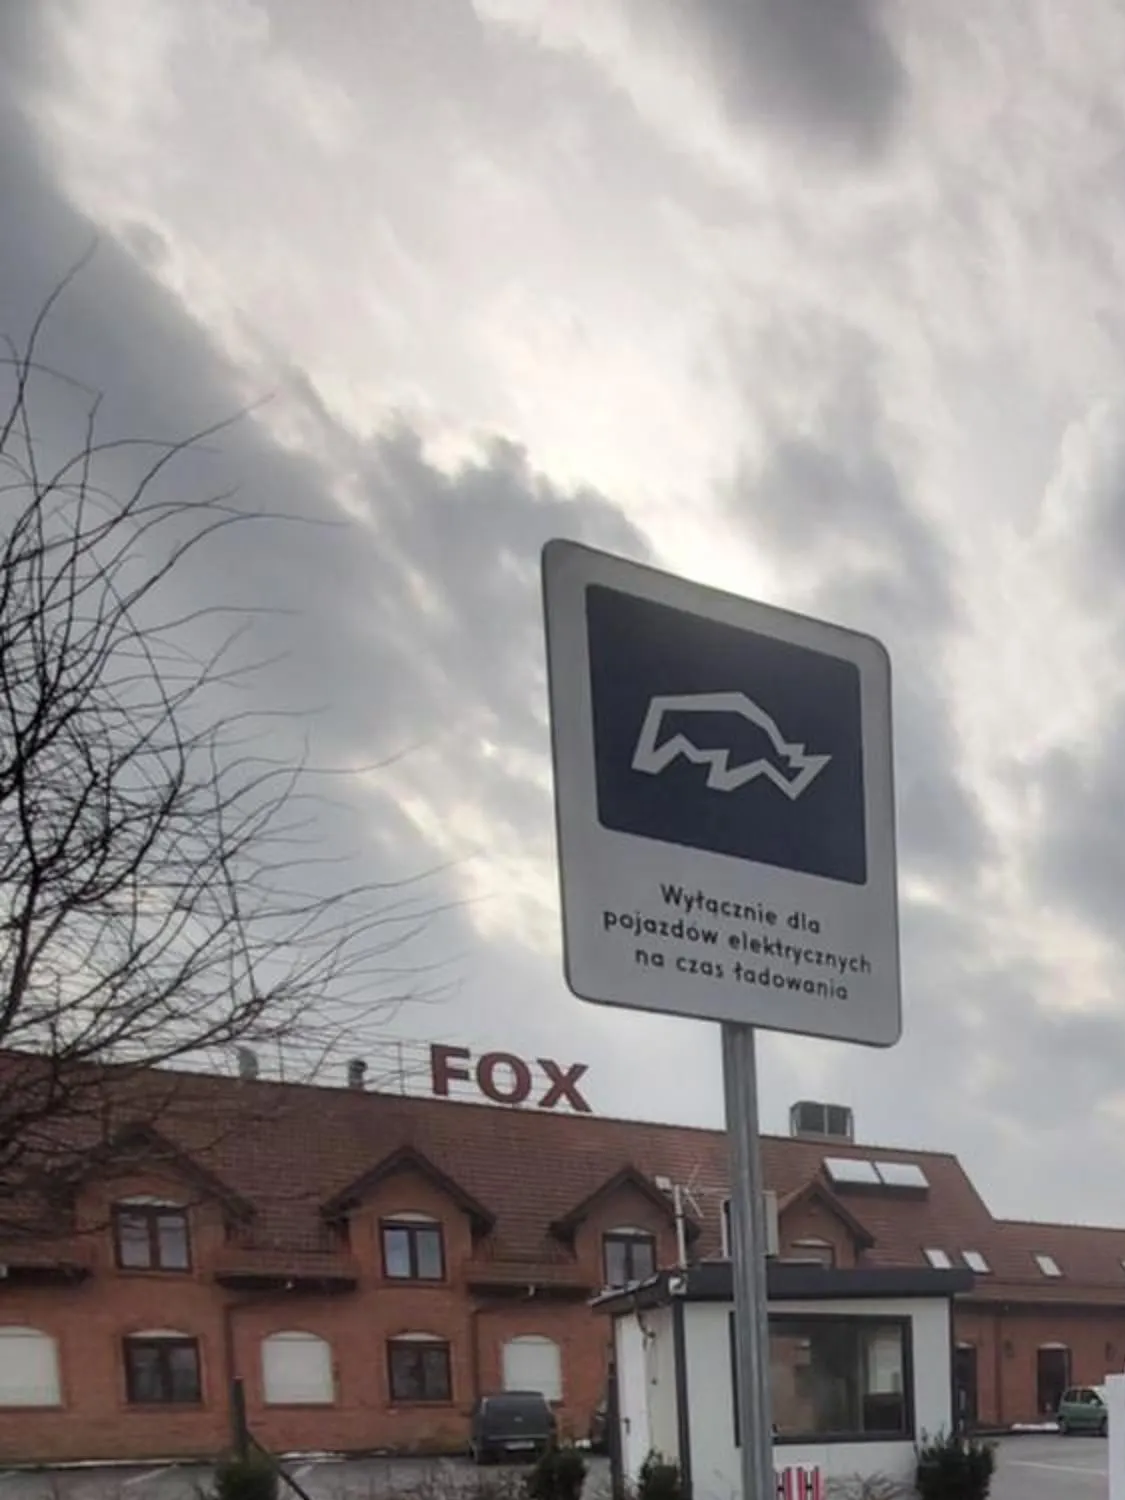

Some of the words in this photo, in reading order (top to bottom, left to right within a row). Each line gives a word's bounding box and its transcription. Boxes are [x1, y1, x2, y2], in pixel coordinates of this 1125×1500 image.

[660, 882, 778, 927] Wyłącznie
[787, 909, 821, 934] dla
[603, 910, 719, 947] pojazdów
[728, 931, 872, 974] elektrycznych
[635, 947, 664, 967] na
[676, 954, 724, 979] czas
[733, 964, 849, 1000] ładowania
[430, 1043, 593, 1113] FOX
